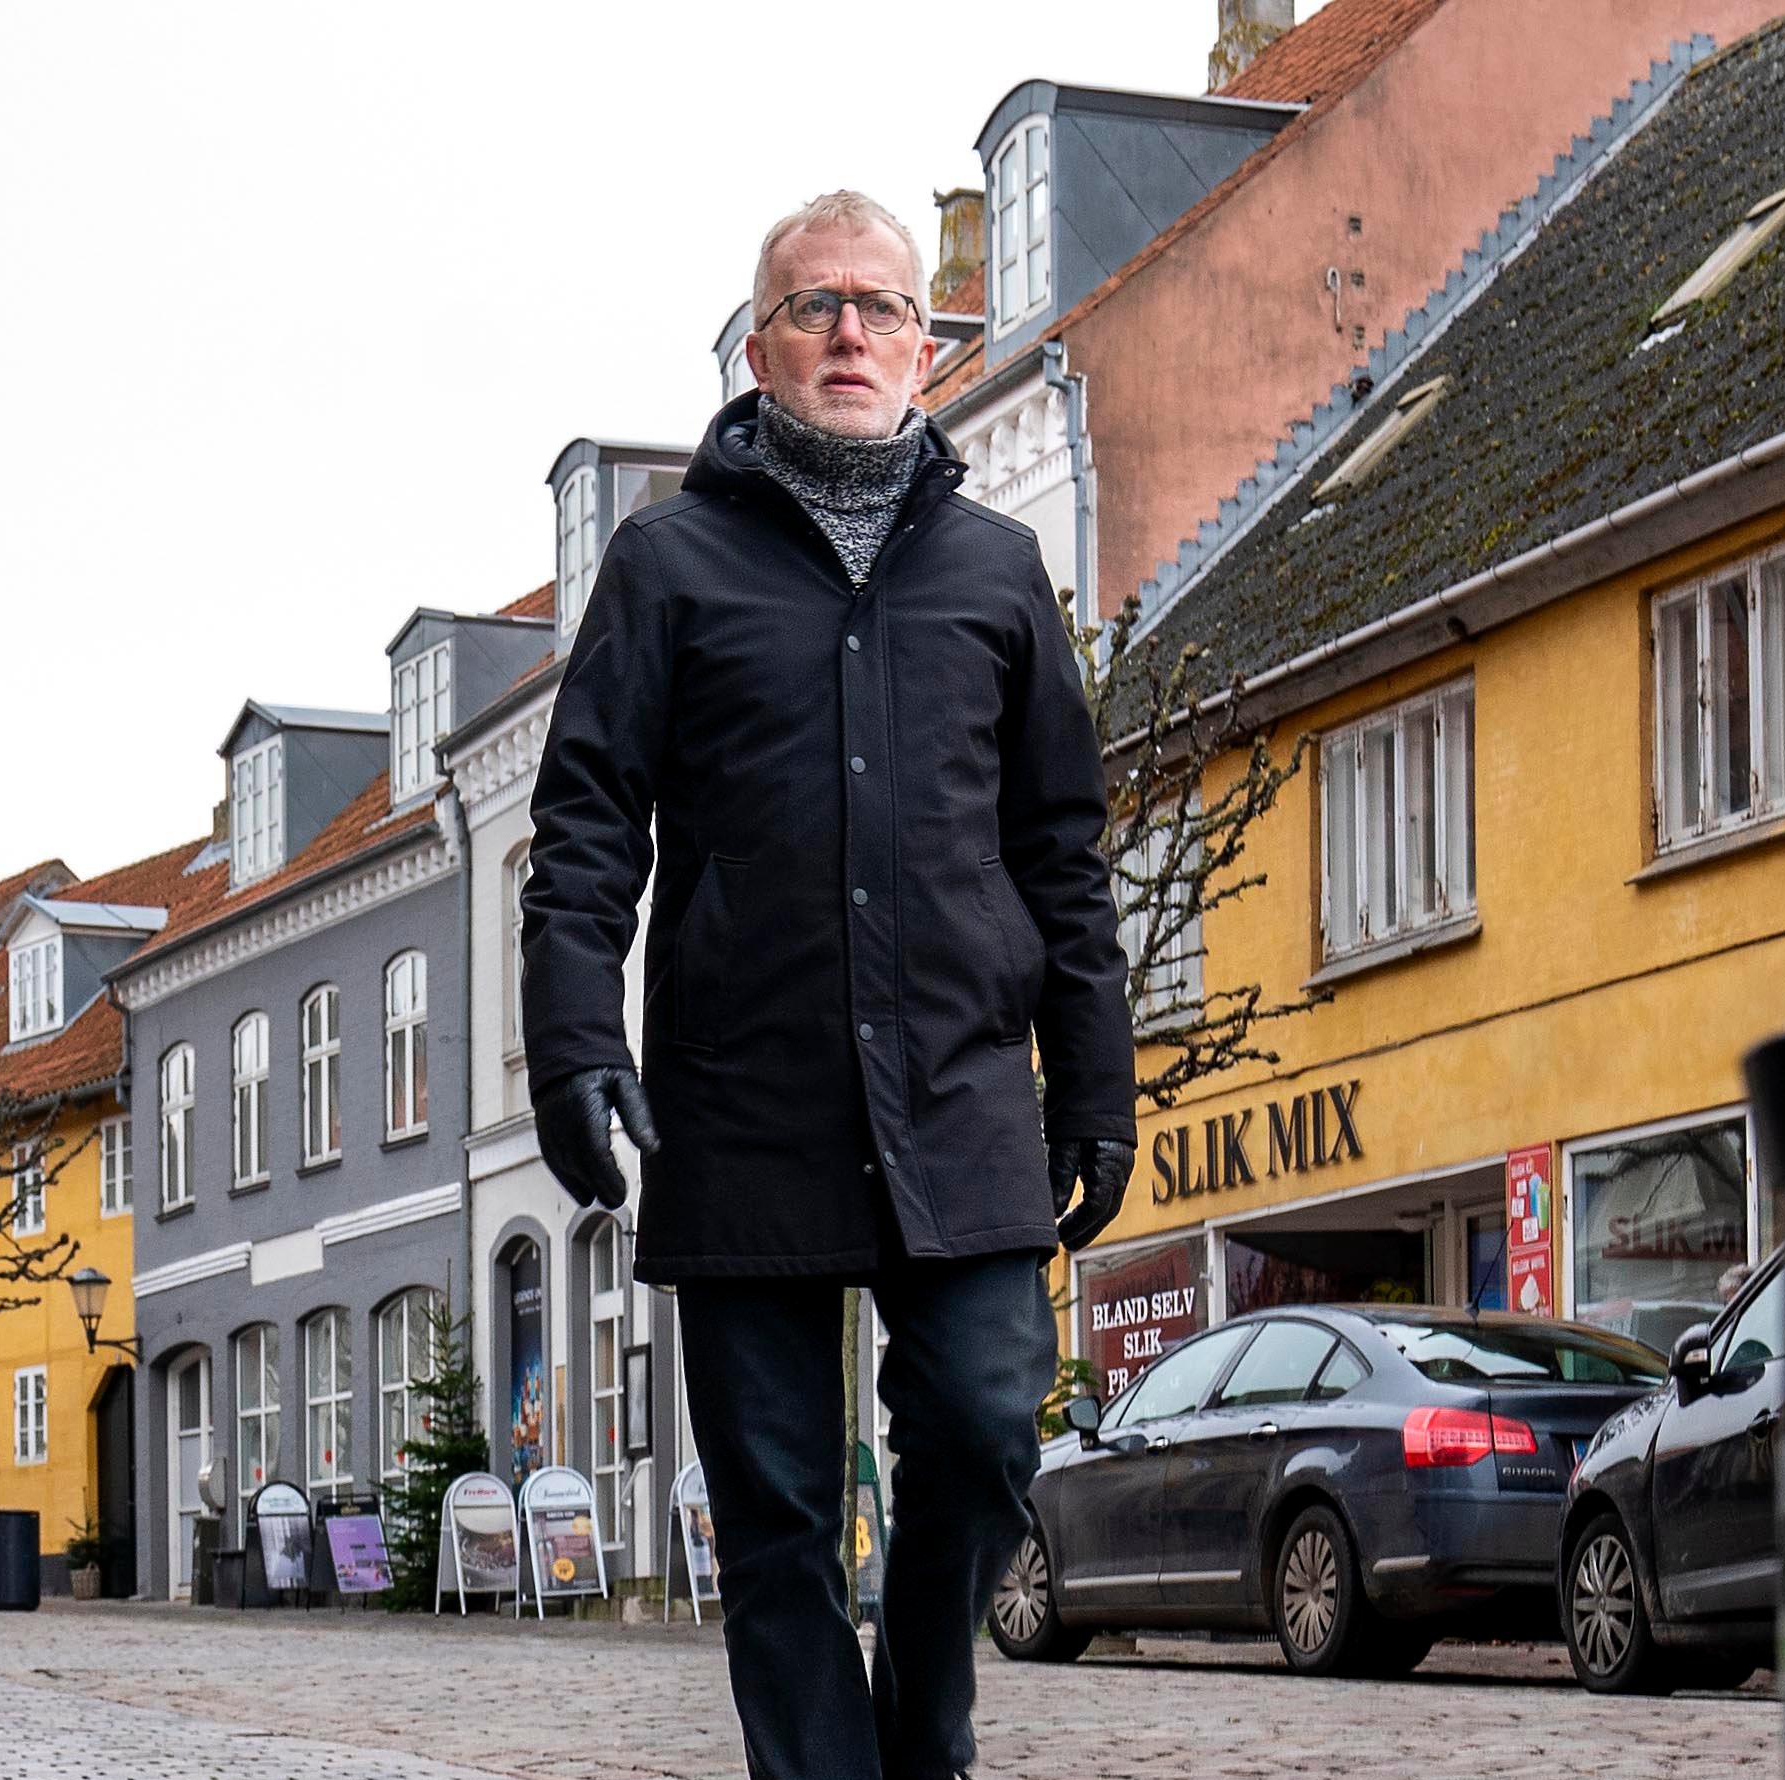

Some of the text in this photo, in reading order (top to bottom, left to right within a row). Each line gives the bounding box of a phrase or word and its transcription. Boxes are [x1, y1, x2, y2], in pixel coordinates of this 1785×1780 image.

[1152, 1078, 1363, 1206] SLIK MIX
[1608, 1213, 1690, 1254] SLIK
[1092, 1286, 1195, 1332] BLAND SELV
[1123, 1327, 1164, 1360] SLIK
